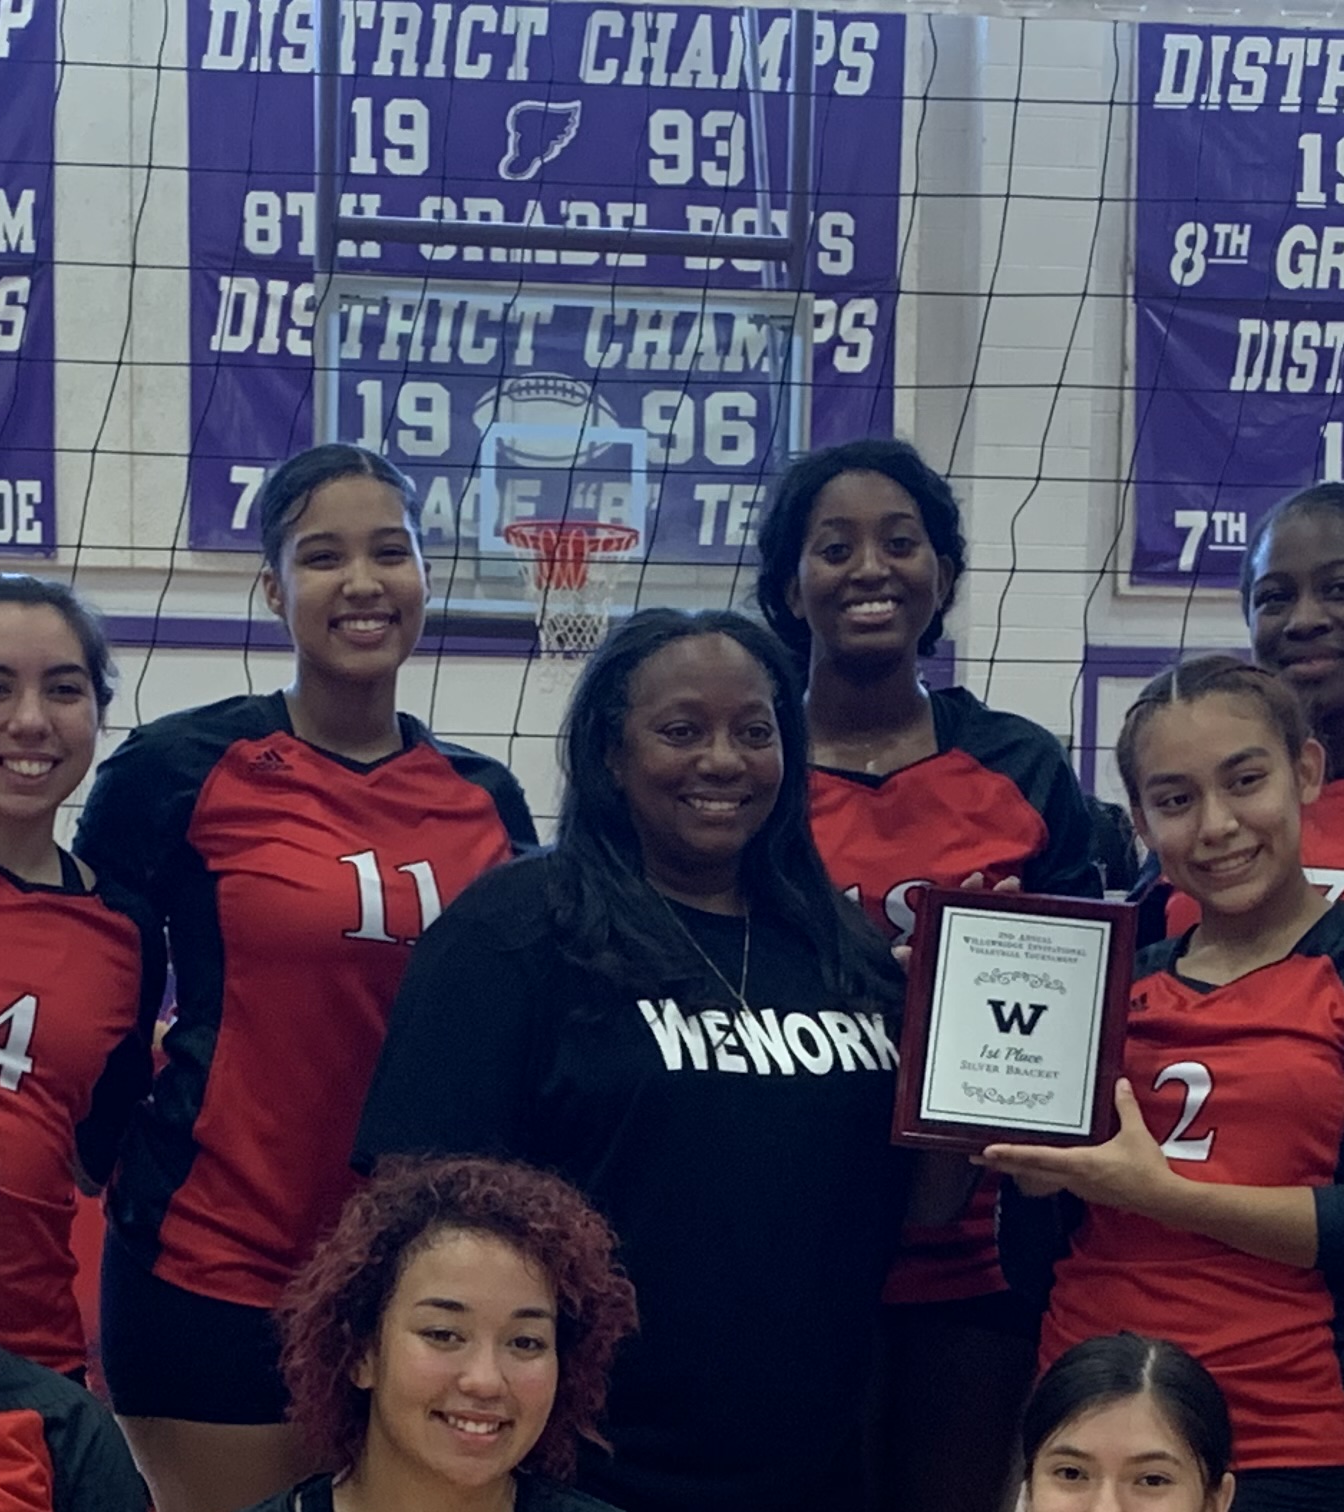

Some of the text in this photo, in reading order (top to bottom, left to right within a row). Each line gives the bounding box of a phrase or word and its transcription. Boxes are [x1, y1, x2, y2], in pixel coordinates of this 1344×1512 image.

[349, 96, 747, 187] 19 93
[356, 379, 757, 467] 19 96
[693, 483, 767, 546] TE
[336, 848, 444, 946] 11
[986, 998, 1049, 1036] W
[1151, 1060, 1217, 1162] 2
